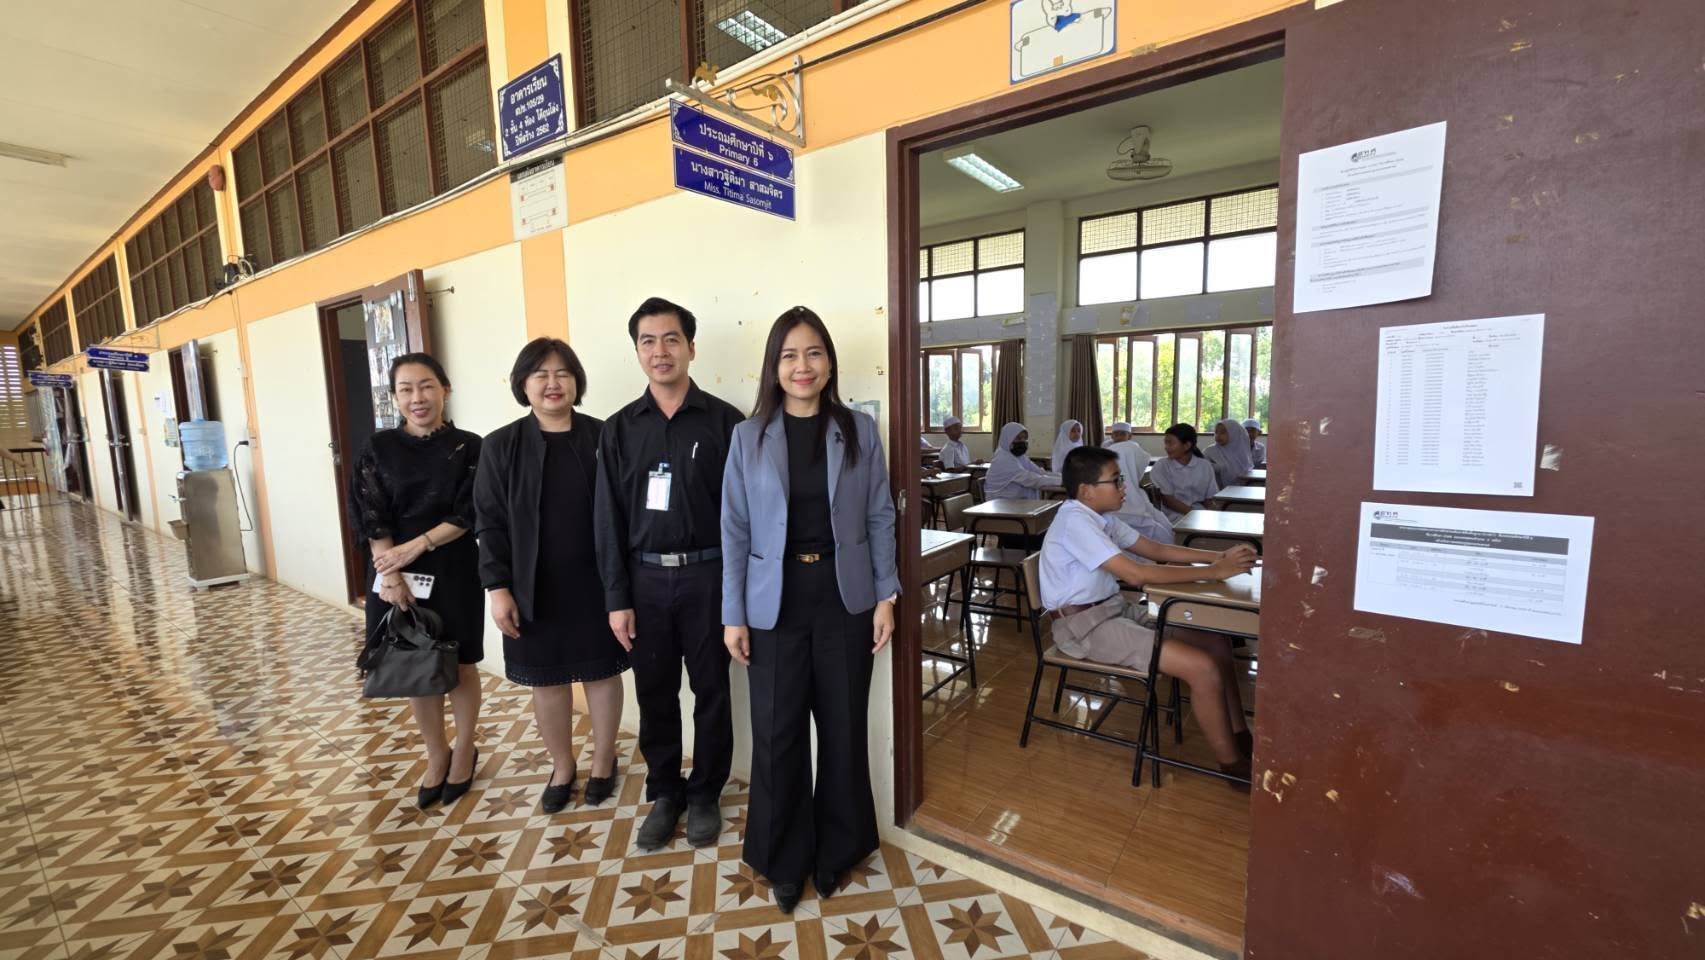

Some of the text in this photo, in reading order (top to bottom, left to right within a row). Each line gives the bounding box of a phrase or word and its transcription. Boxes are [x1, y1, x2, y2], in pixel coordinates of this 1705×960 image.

[510, 75, 548, 105] อาคารเรียน
[505, 128, 509, 137] 2
[510, 119, 518, 135] ชั้น
[519, 120, 523, 130] 4
[524, 115, 535, 127] ห้อง
[536, 122, 550, 137] 2562
[699, 122, 774, 161] ประถมศึกษาปีที่ ๖
[719, 144, 759, 167] Primary 6
[691, 161, 746, 187] นางสาวฐิติมา
[704, 180, 773, 210] Miss. Titima Sasomjit
